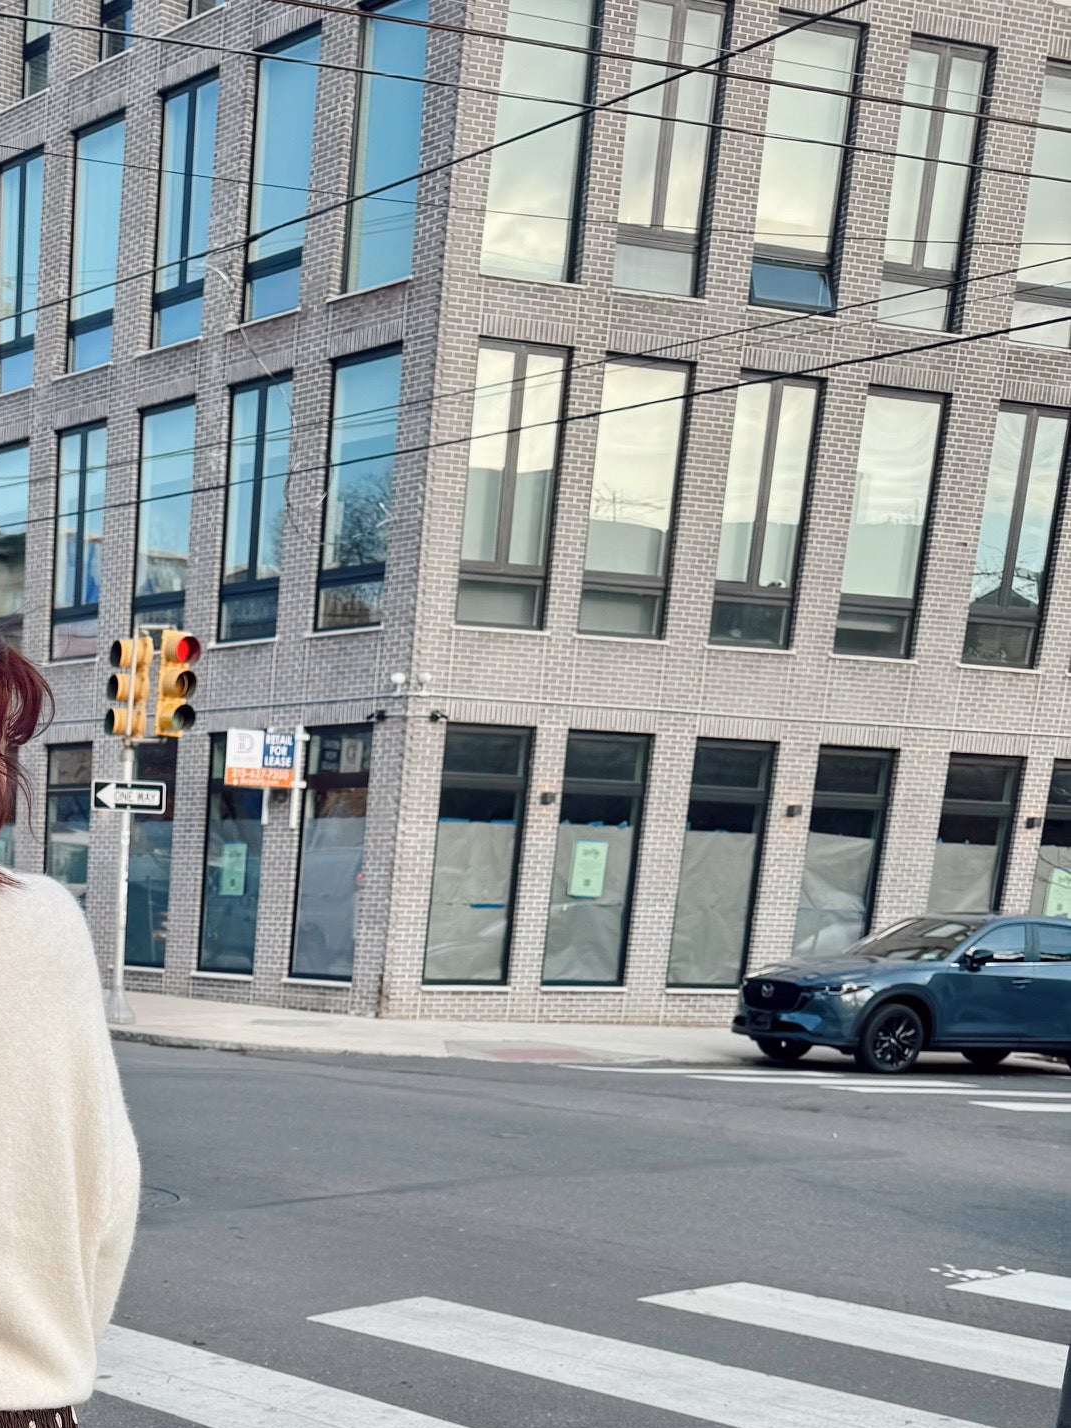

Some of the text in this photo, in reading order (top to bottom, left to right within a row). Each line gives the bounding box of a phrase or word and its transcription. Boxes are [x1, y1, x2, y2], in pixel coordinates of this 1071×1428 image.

[265, 734, 293, 745] RETAIL
[269, 745, 288, 756] FOR
[264, 756, 292, 767] LEASE
[114, 791, 156, 803] ONE WAY
